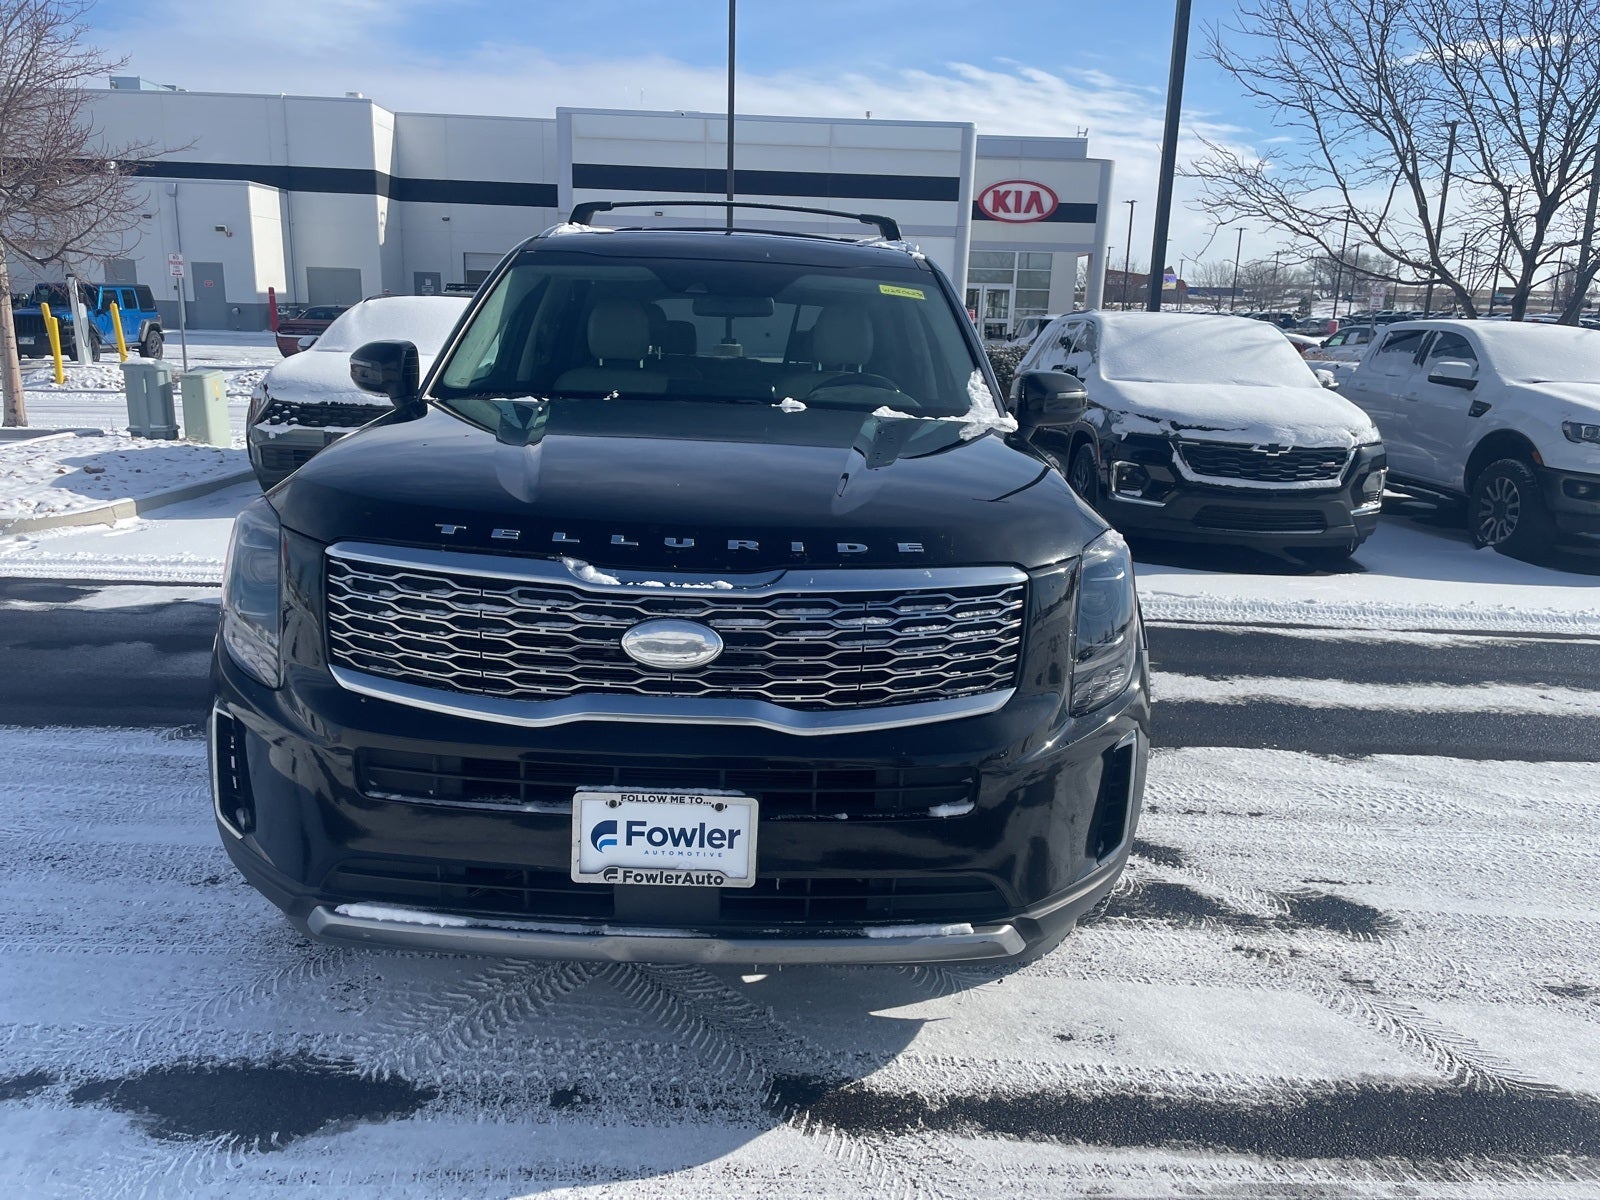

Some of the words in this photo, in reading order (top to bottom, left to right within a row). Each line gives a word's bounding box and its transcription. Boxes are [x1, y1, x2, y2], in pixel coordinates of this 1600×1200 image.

[991, 189, 1045, 214] KIA
[434, 523, 925, 553] TELLURIDE
[620, 794, 668, 803] FOLLOW
[670, 796, 686, 804] ME
[689, 796, 712, 805] TO...
[625, 820, 741, 849] Fowler
[644, 850, 723, 858] AUTOMOTIVE
[622, 870, 724, 886] FowlerAuto
